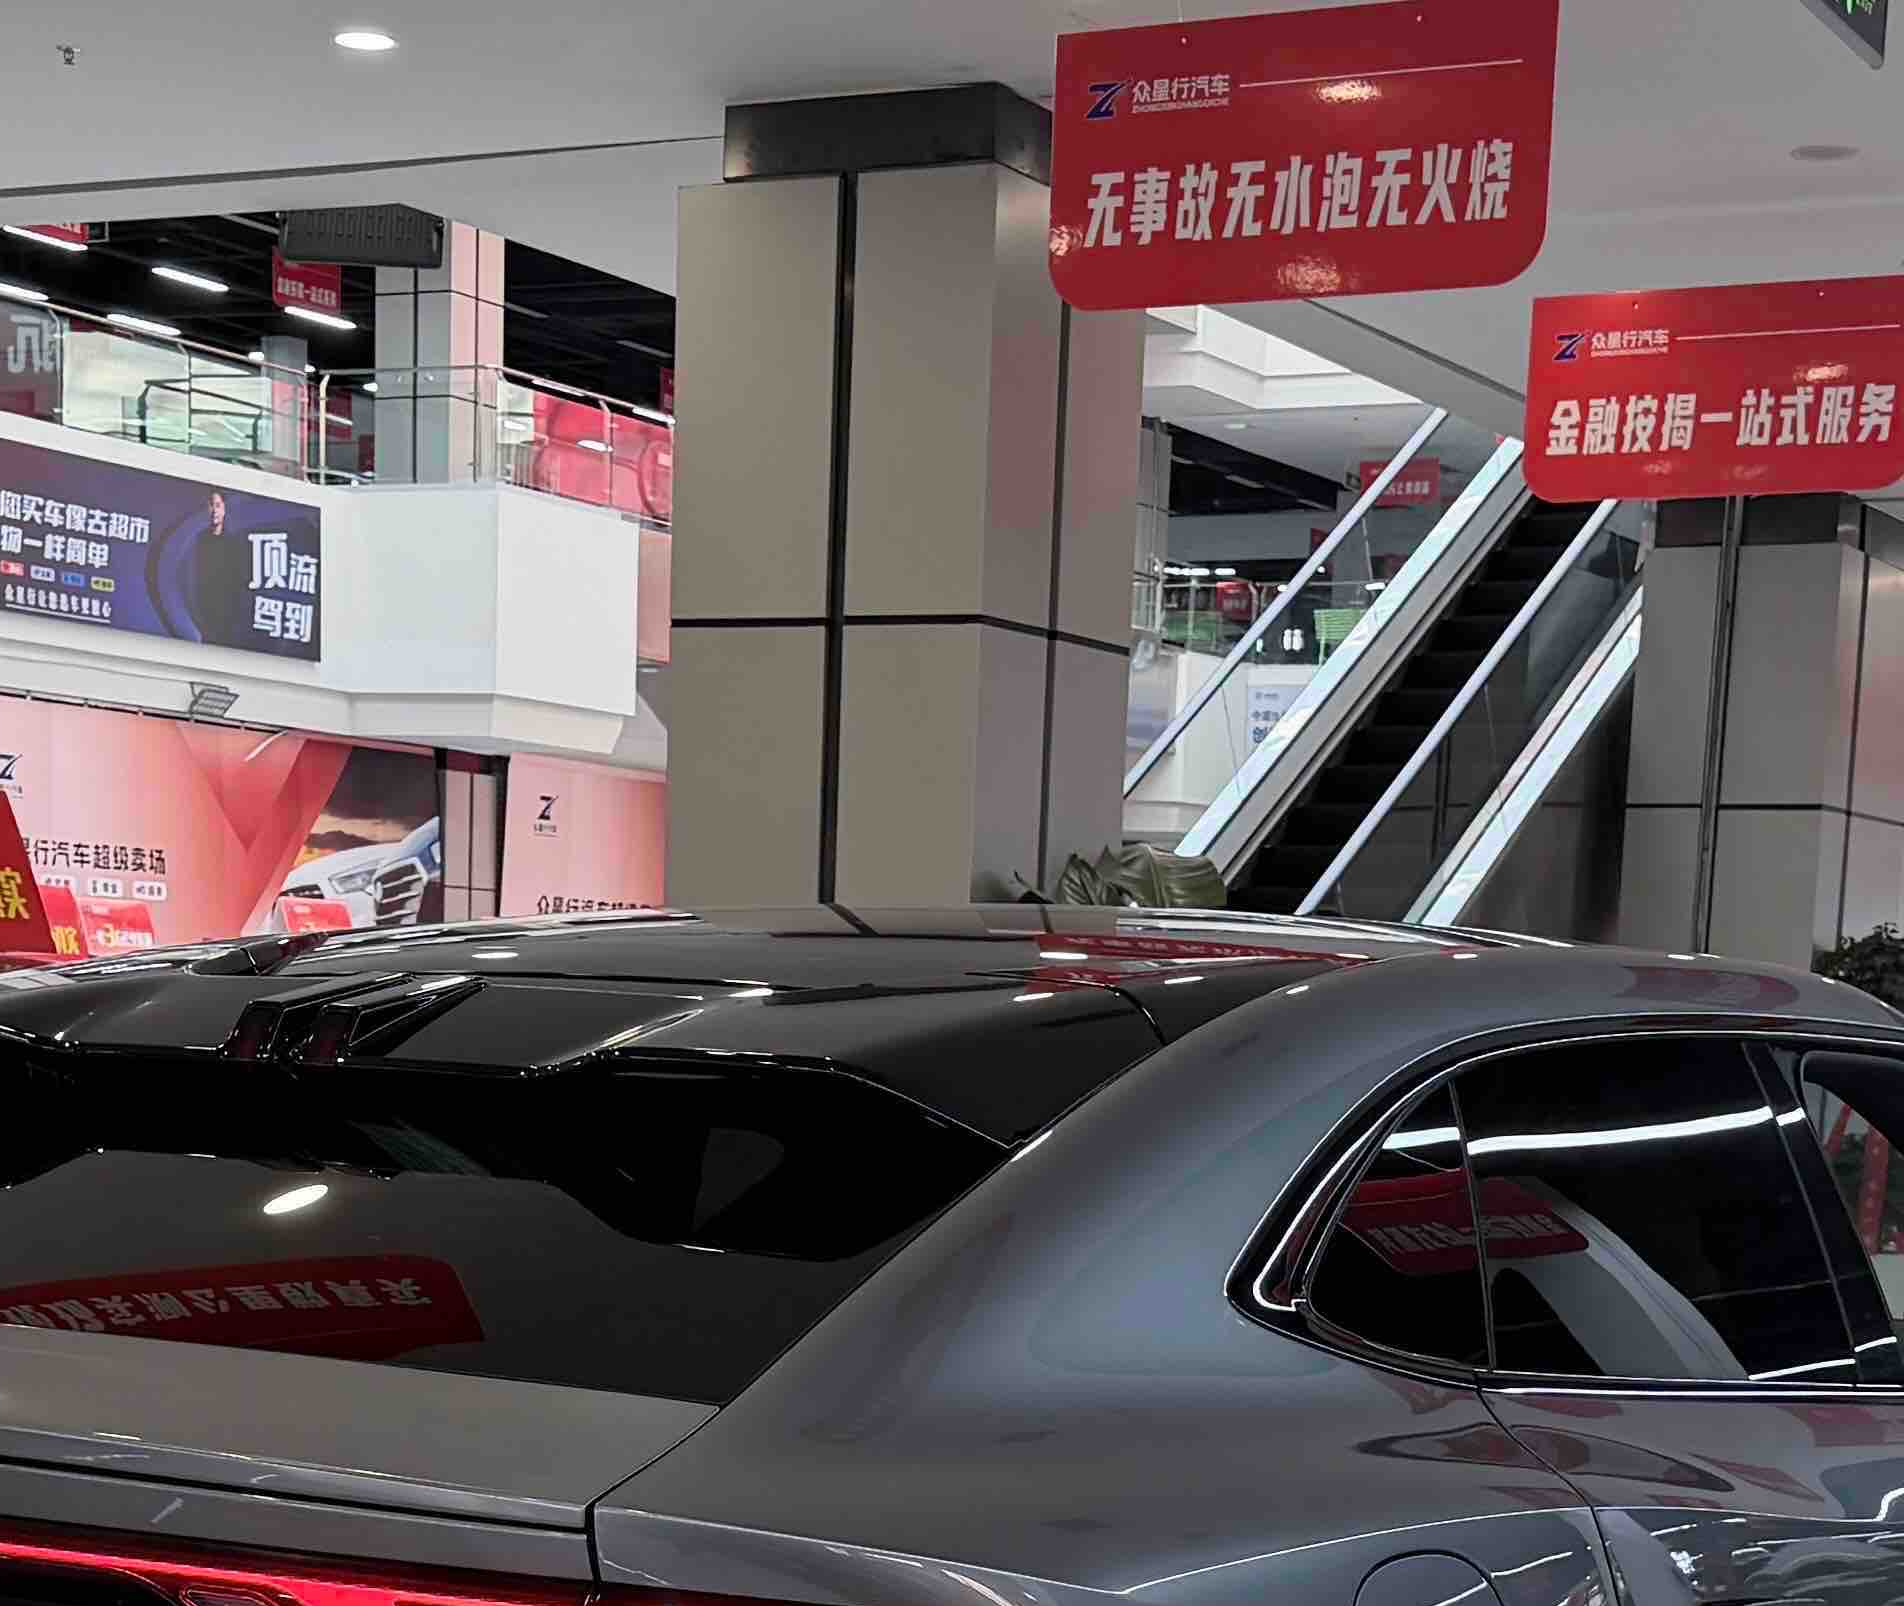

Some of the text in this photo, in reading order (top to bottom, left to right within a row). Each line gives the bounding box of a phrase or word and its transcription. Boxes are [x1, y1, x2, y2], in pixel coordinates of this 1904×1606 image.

[1131, 74, 1230, 104] 众星行汽车
[1082, 137, 1514, 249] 无事故无水泡无火烧
[1590, 329, 1670, 353] 众星行汽车
[1544, 383, 1897, 457] 金融按揭一站式服务
[248, 531, 319, 595] 顶流
[252, 595, 314, 644] 驾到
